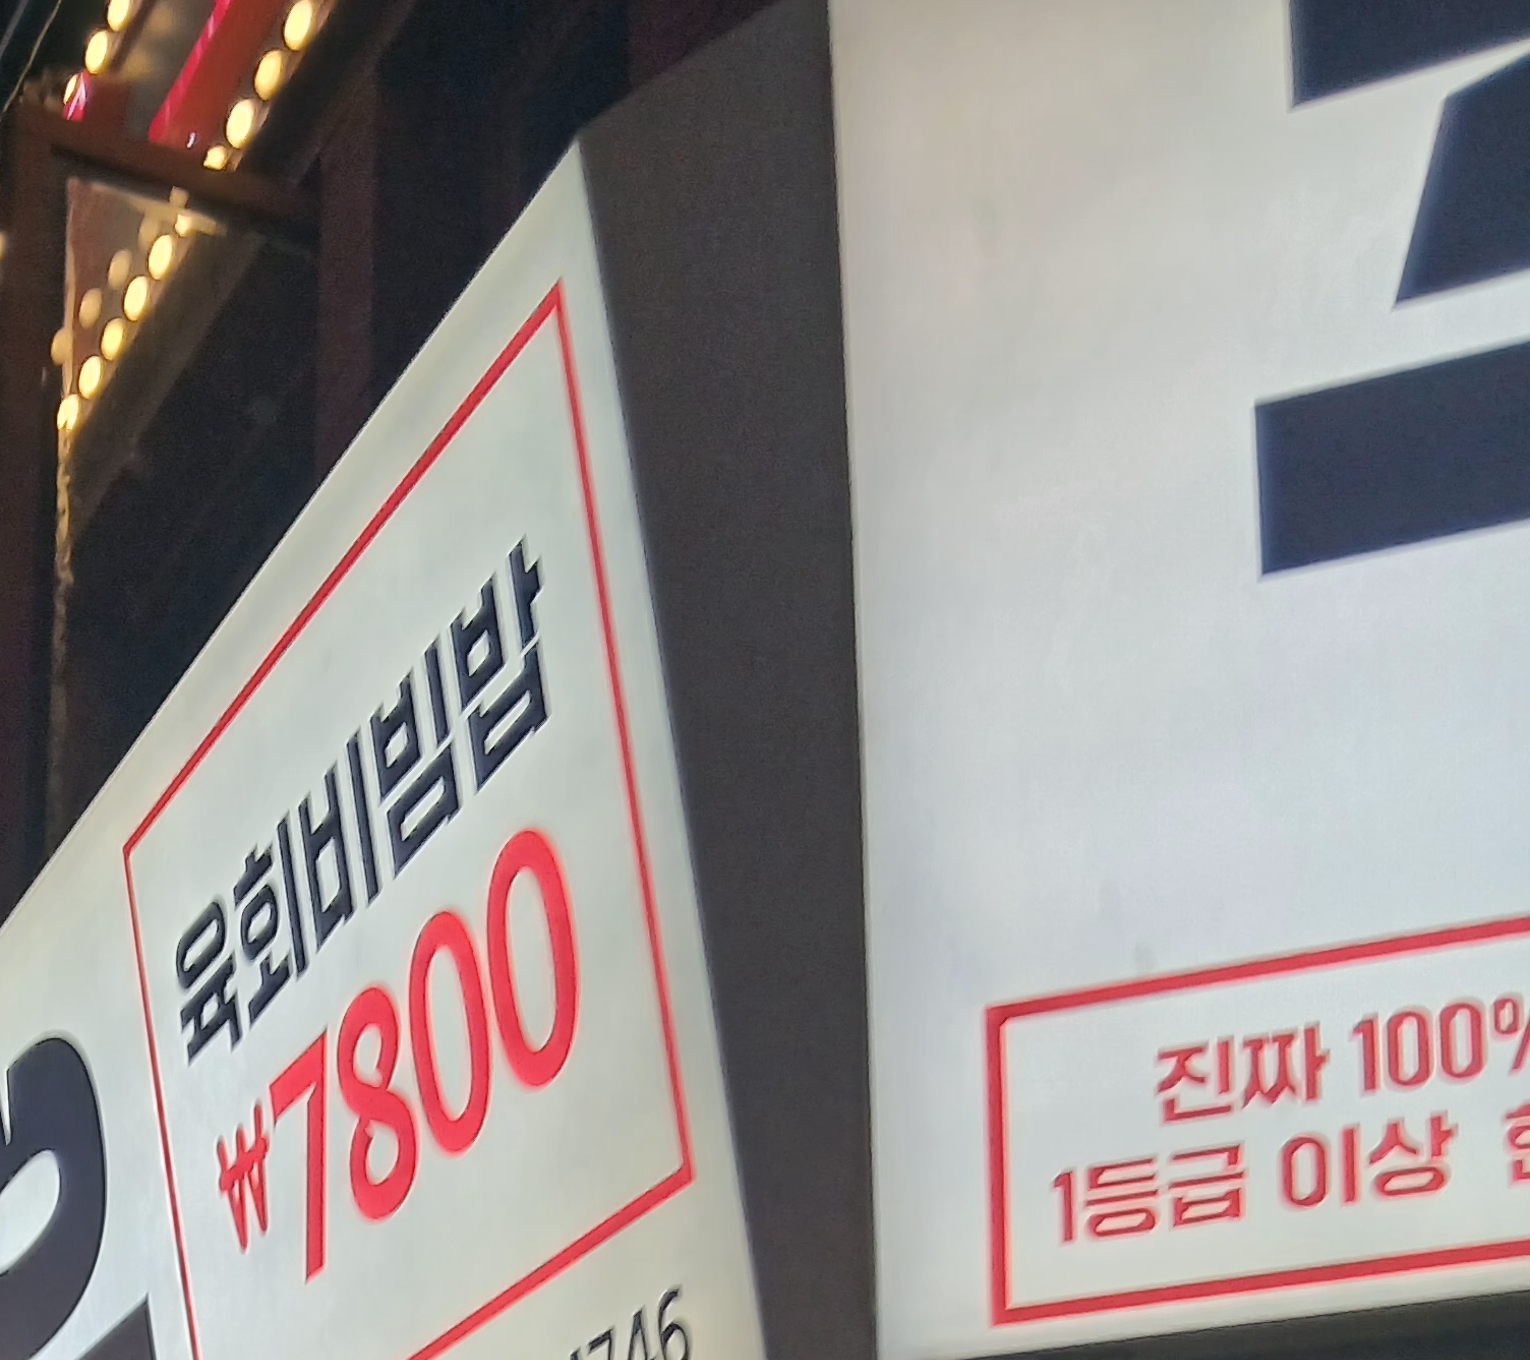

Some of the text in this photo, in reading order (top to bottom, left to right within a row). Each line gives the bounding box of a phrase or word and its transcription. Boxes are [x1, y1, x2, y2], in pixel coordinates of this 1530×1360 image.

[176, 538, 550, 1061] 육회비빔밥
[216, 828, 581, 1282] ₩7800
[1051, 1139, 1246, 1244] 1등급
[1279, 1110, 1459, 1210] 이상
[1155, 1020, 1330, 1124] 진짜
